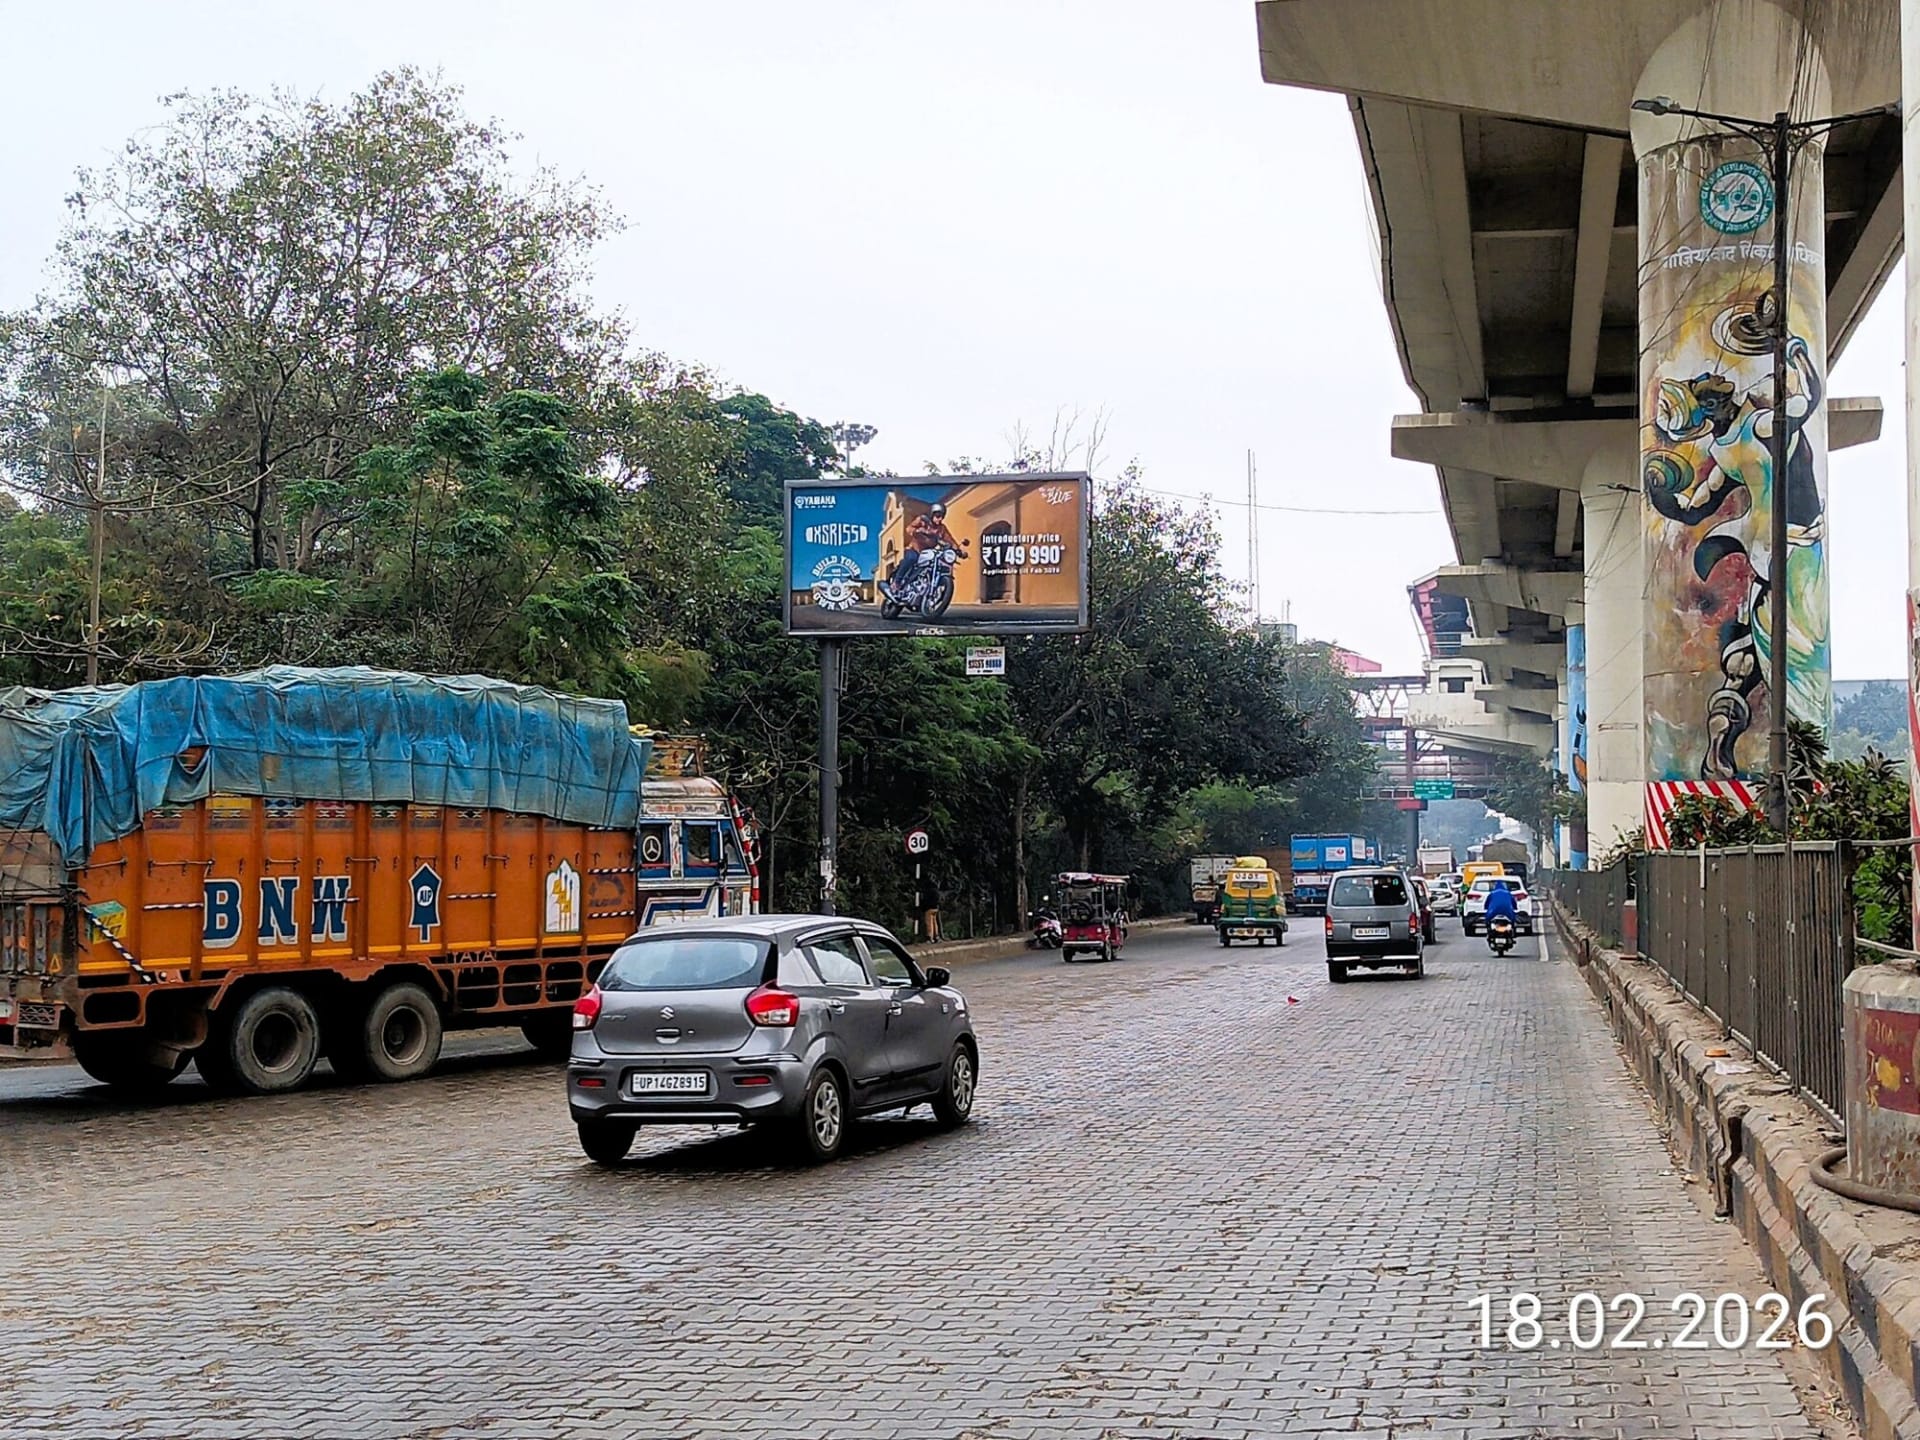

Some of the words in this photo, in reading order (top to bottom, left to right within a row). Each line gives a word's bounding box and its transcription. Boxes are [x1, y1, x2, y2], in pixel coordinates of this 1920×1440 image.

[804, 495, 836, 505] YAMAHA
[813, 523, 859, 546] XSR155
[982, 534, 1035, 544] Introductory
[1037, 533, 1060, 543] Price
[910, 836, 927, 848] 30
[639, 1075, 705, 1090] UP14GZ8915
